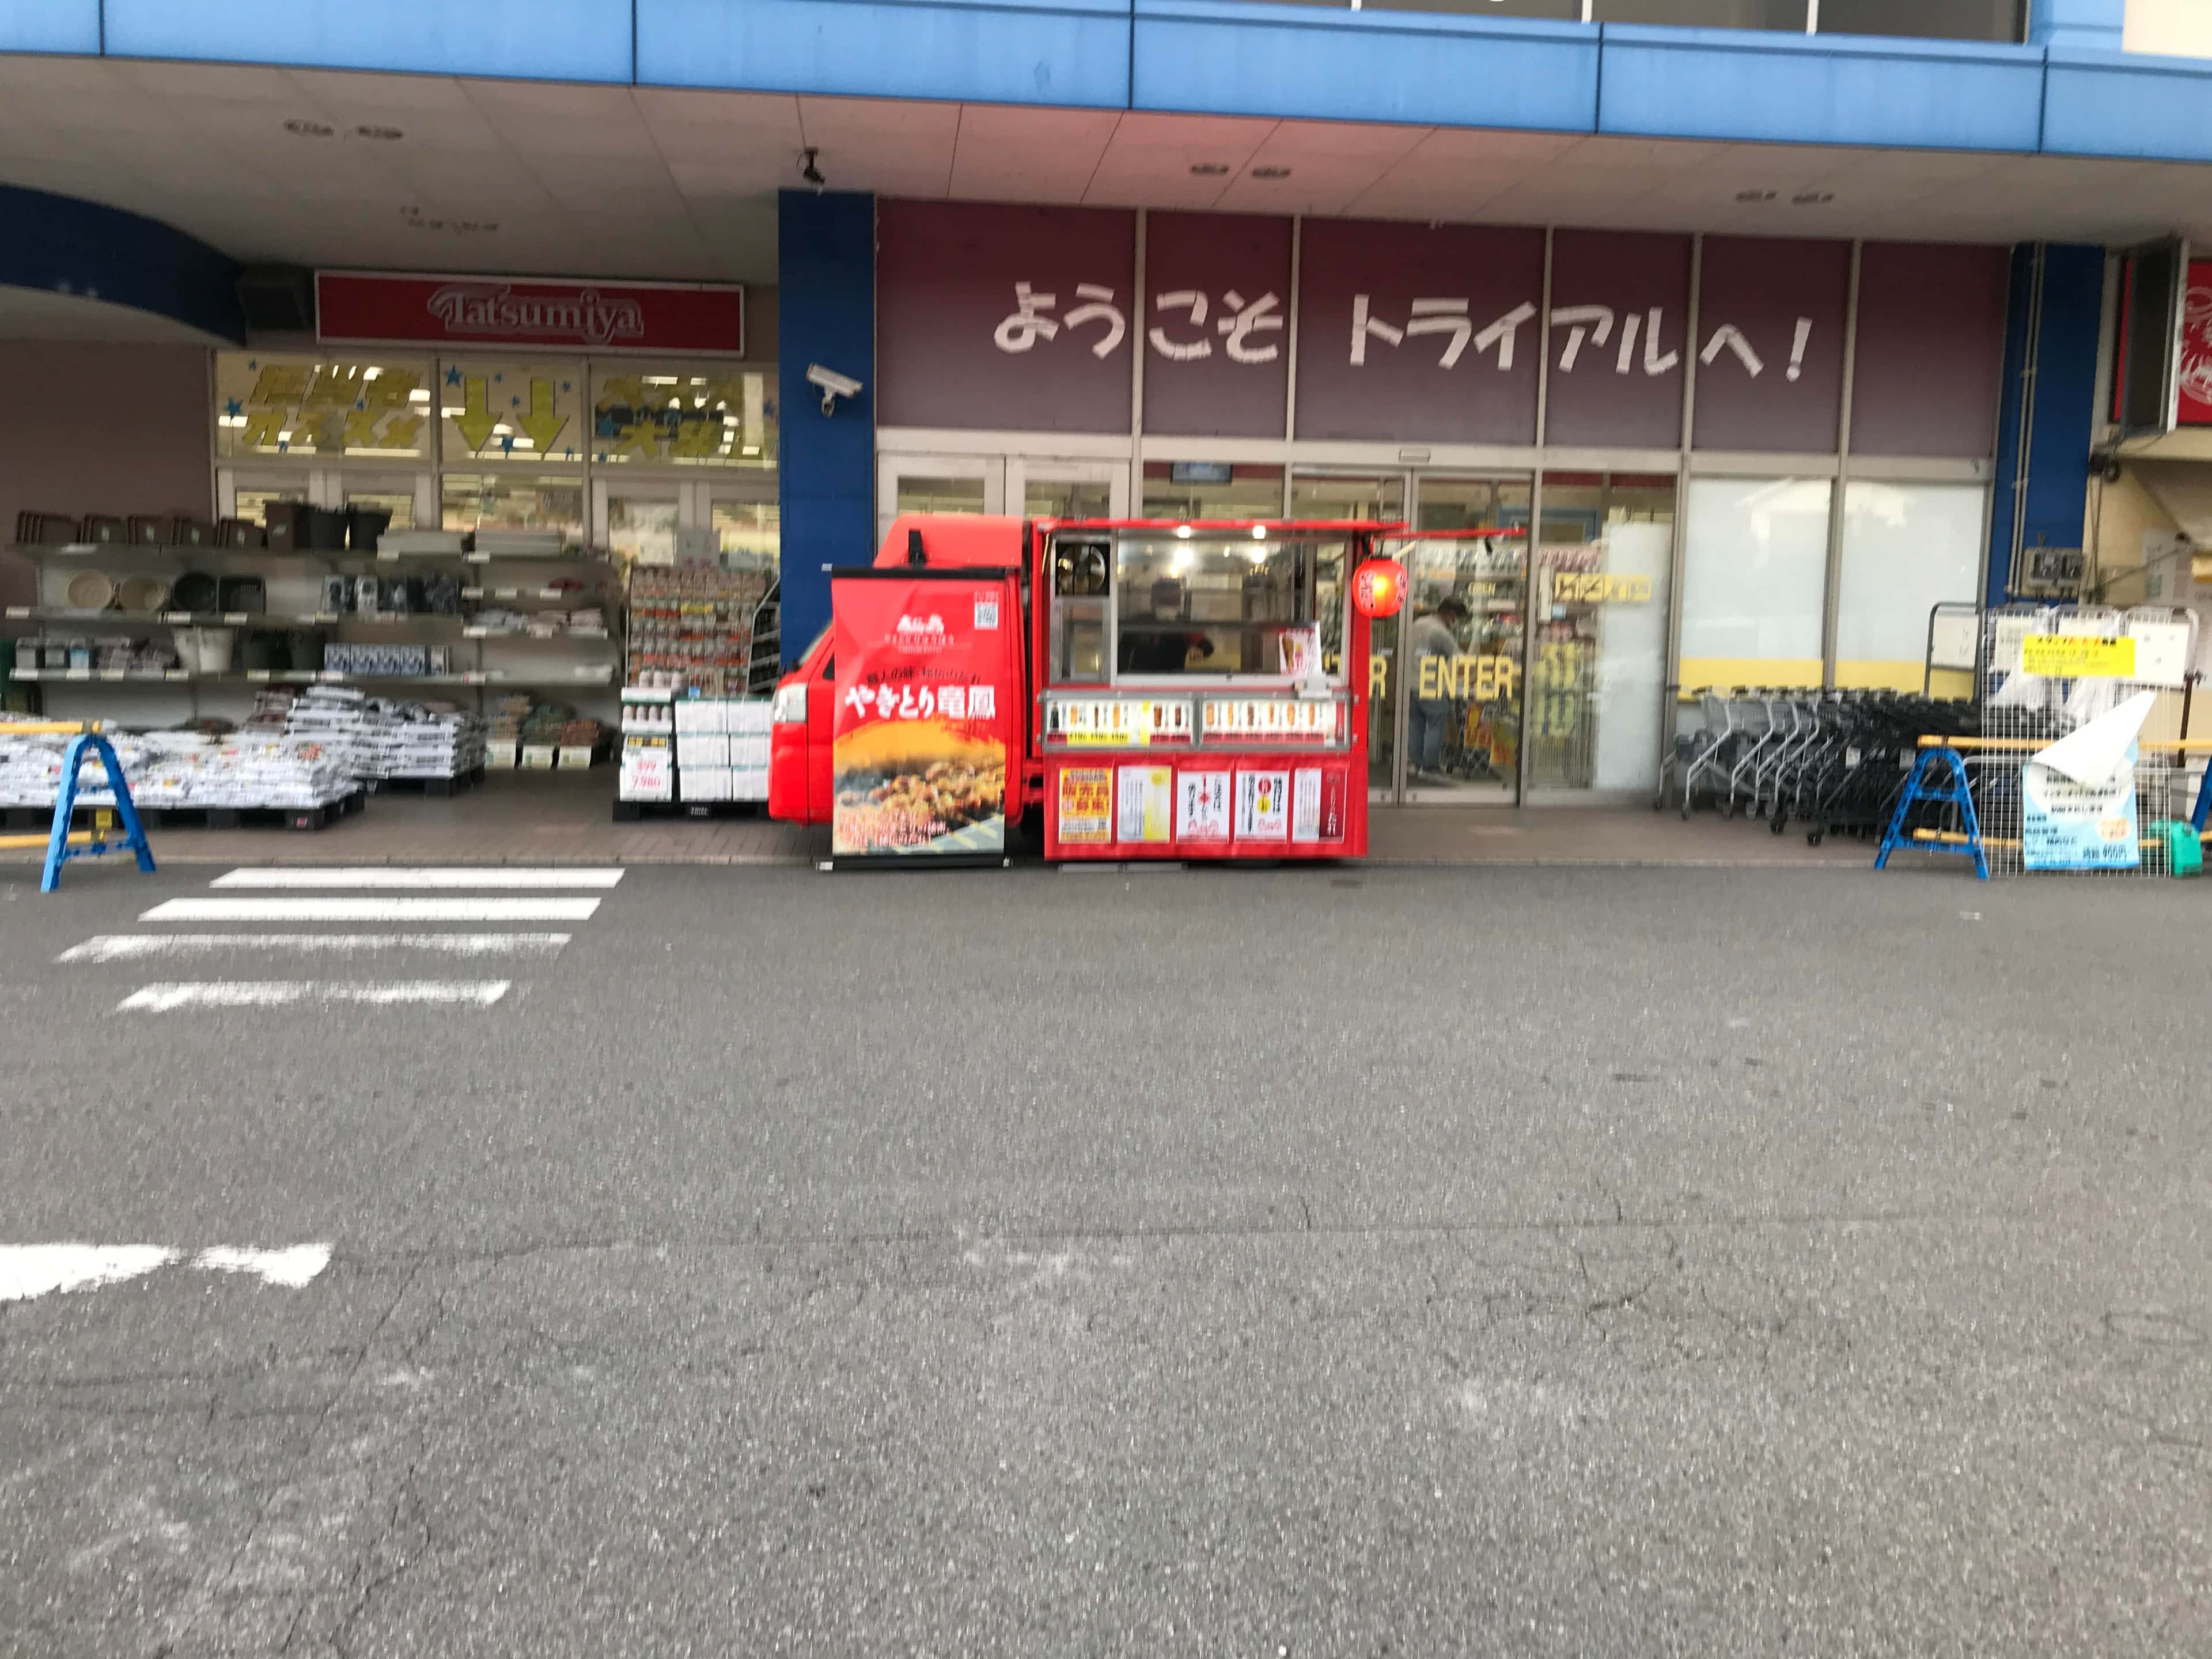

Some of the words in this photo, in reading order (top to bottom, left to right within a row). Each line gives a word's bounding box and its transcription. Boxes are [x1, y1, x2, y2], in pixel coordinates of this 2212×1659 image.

[427, 286, 643, 344] Tatsumiya
[994, 281, 1284, 364] ようこそ
[1419, 654, 1514, 701] ENTER
